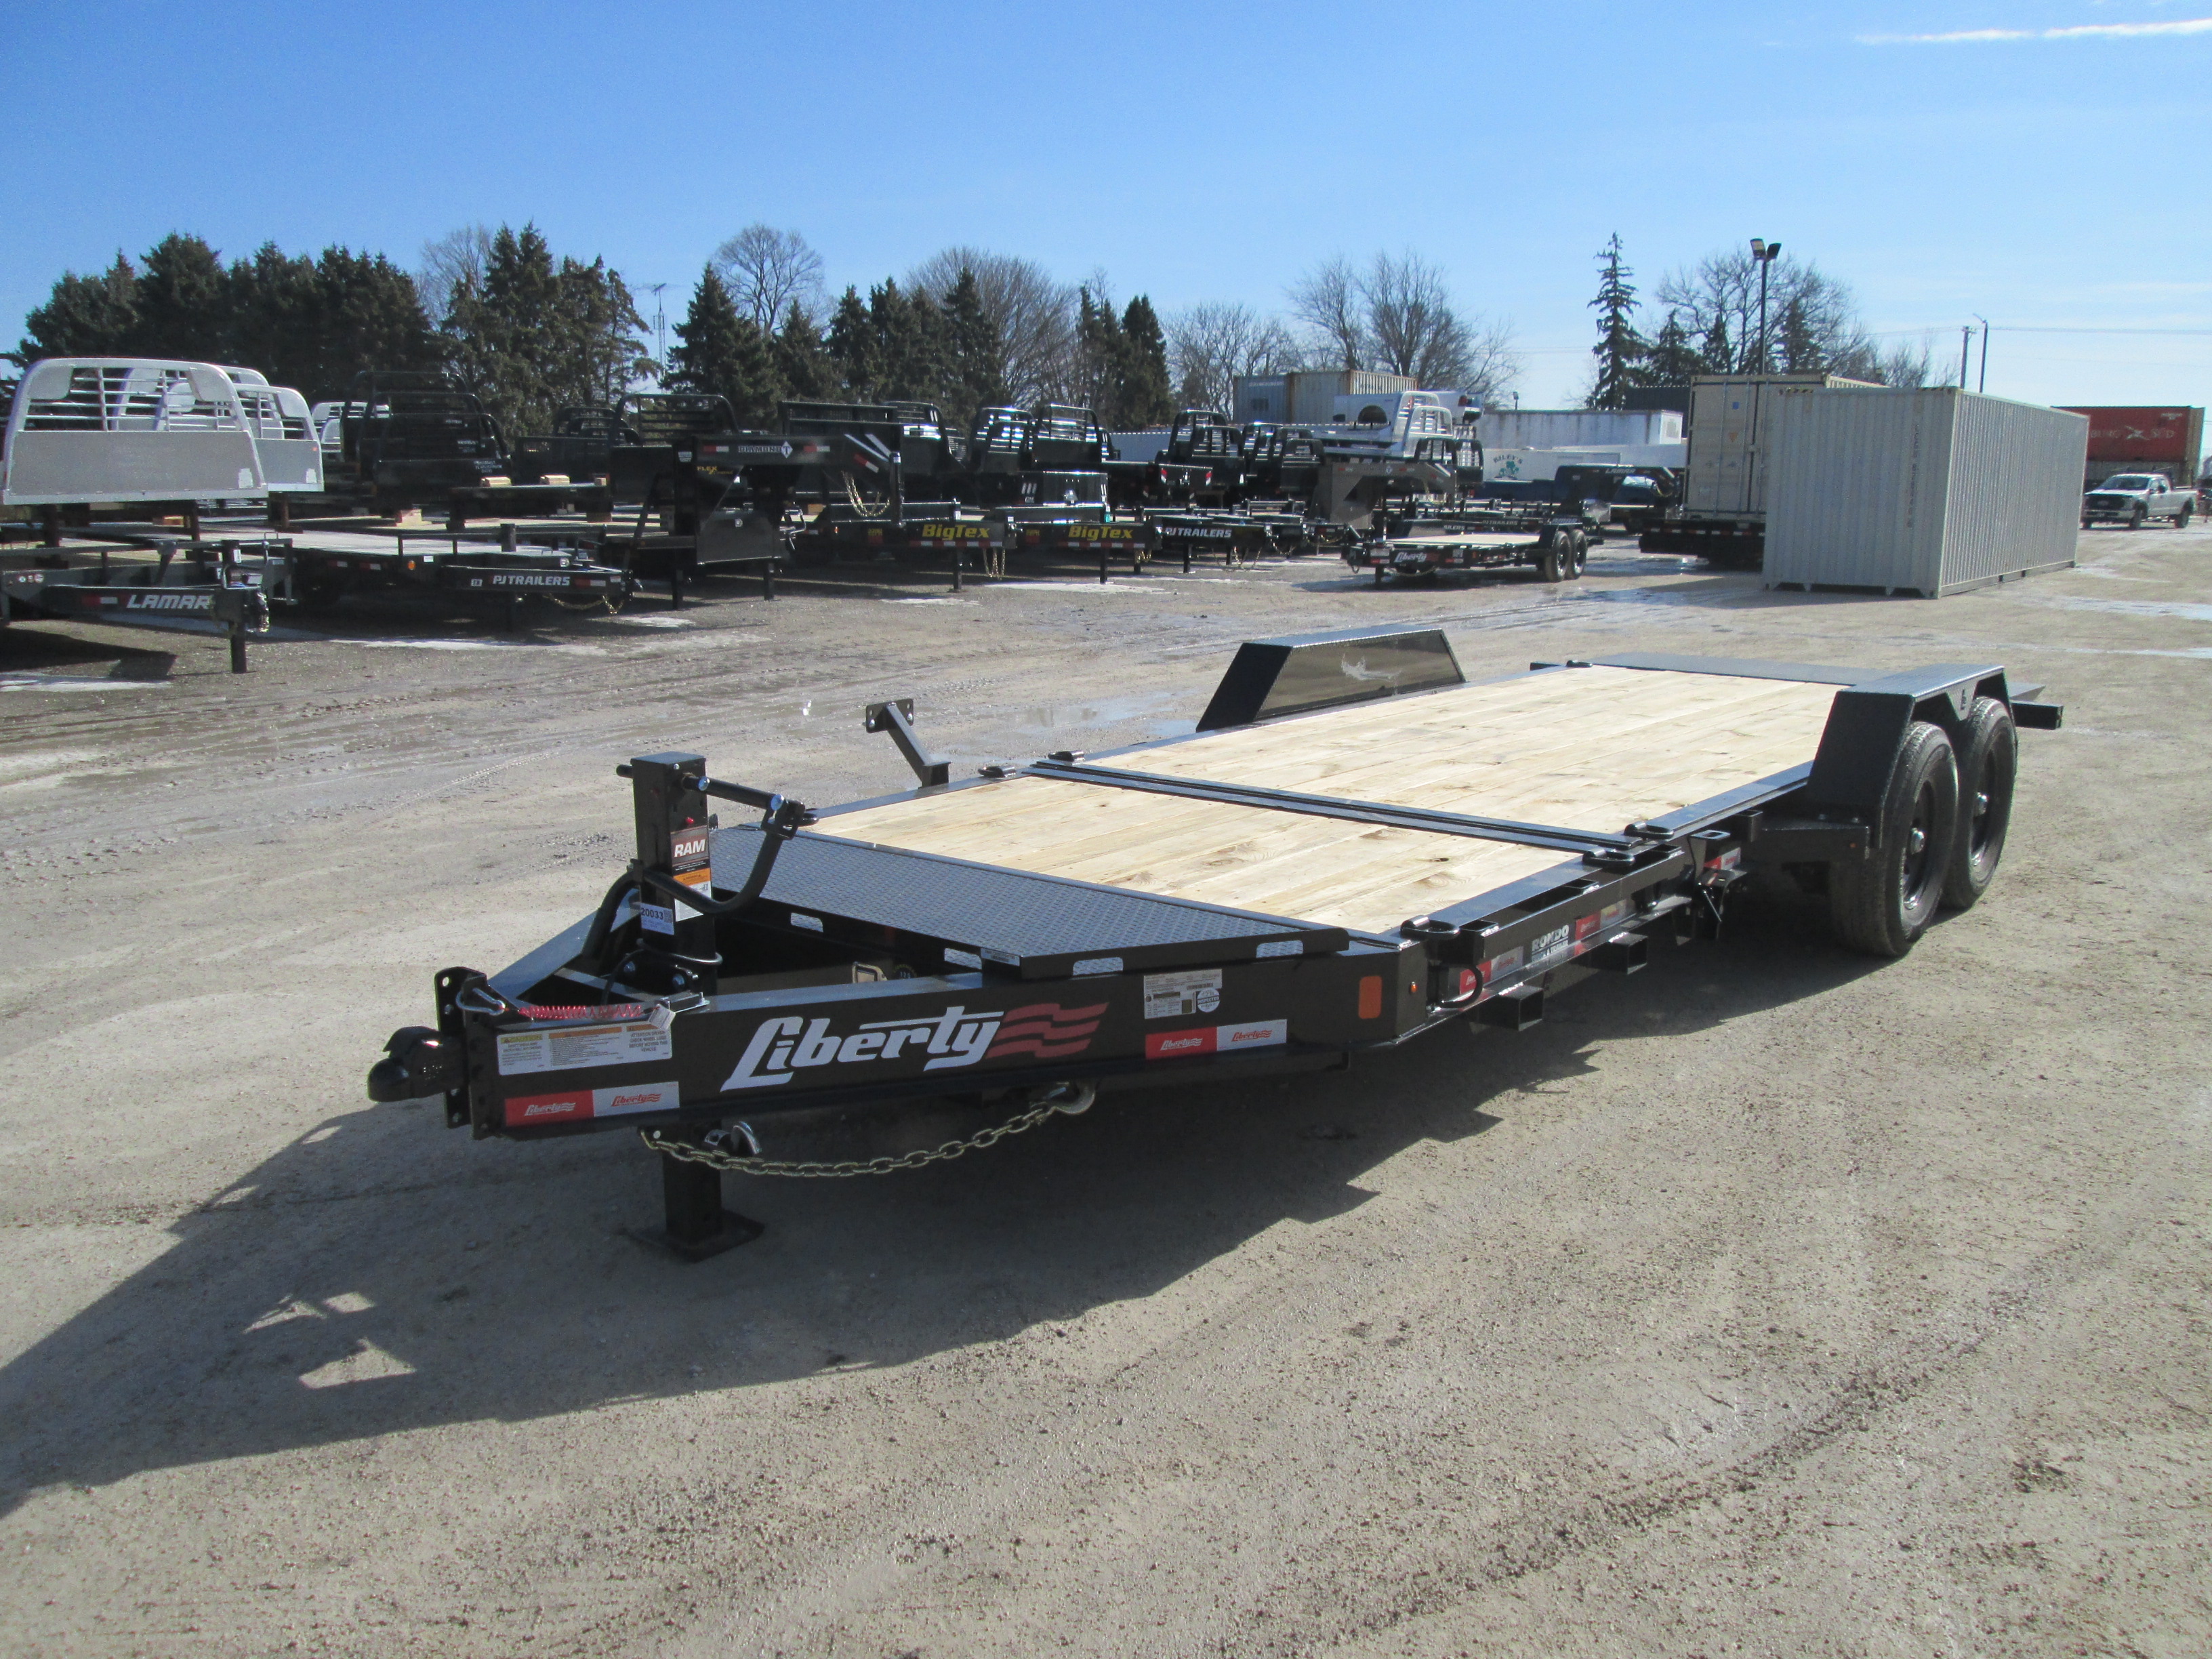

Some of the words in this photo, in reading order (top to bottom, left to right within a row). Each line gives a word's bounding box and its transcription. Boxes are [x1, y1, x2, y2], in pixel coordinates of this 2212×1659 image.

[1178, 528, 1232, 537] TRAILERS
[508, 576, 571, 586] TRAILERS
[126, 594, 212, 609] LAMAR
[674, 839, 706, 858] RAM
[1532, 924, 1570, 951] RONDO
[720, 1006, 1004, 1092] Liberty
[611, 1094, 648, 1107] Liberty
[525, 1102, 562, 1117] Liberty
